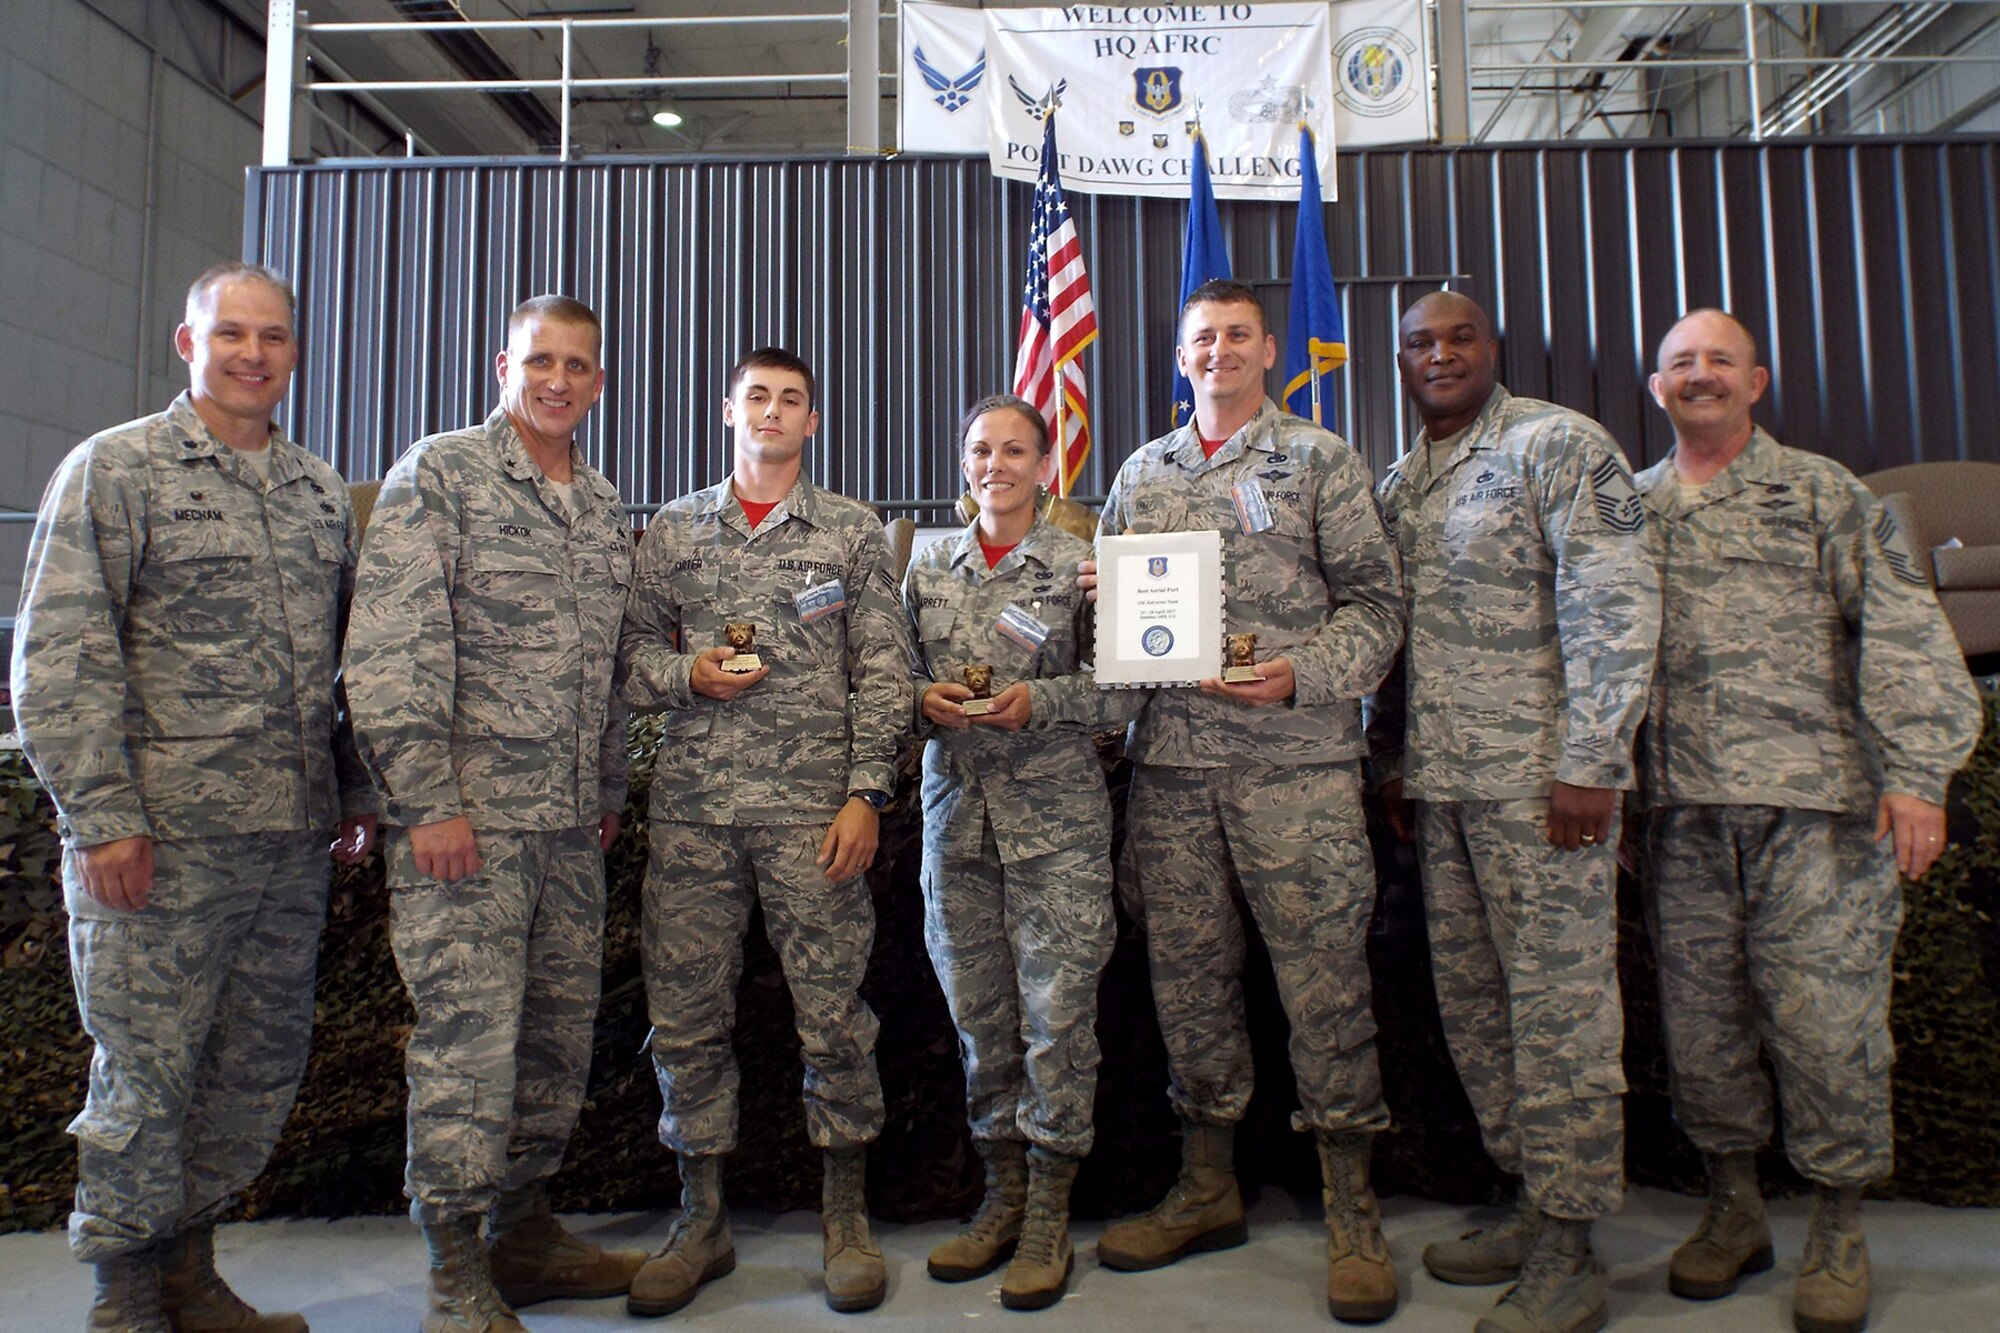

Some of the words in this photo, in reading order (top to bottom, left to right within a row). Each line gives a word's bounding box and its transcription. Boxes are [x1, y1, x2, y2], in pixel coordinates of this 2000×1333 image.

[1061, 6, 1206, 24] WELCOME
[1216, 4, 1252, 21] TO
[1093, 35, 1137, 60] HQ
[1143, 34, 1221, 56] AFRC
[1007, 142, 1071, 170] POT
[1079, 155, 1154, 177] DAWG
[1161, 156, 1301, 178] CHLLENG
[1485, 487, 1517, 500] FORCE
[174, 509, 223, 522] MECHAM
[797, 560, 813, 572] AIR
[814, 561, 844, 576] FORCE
